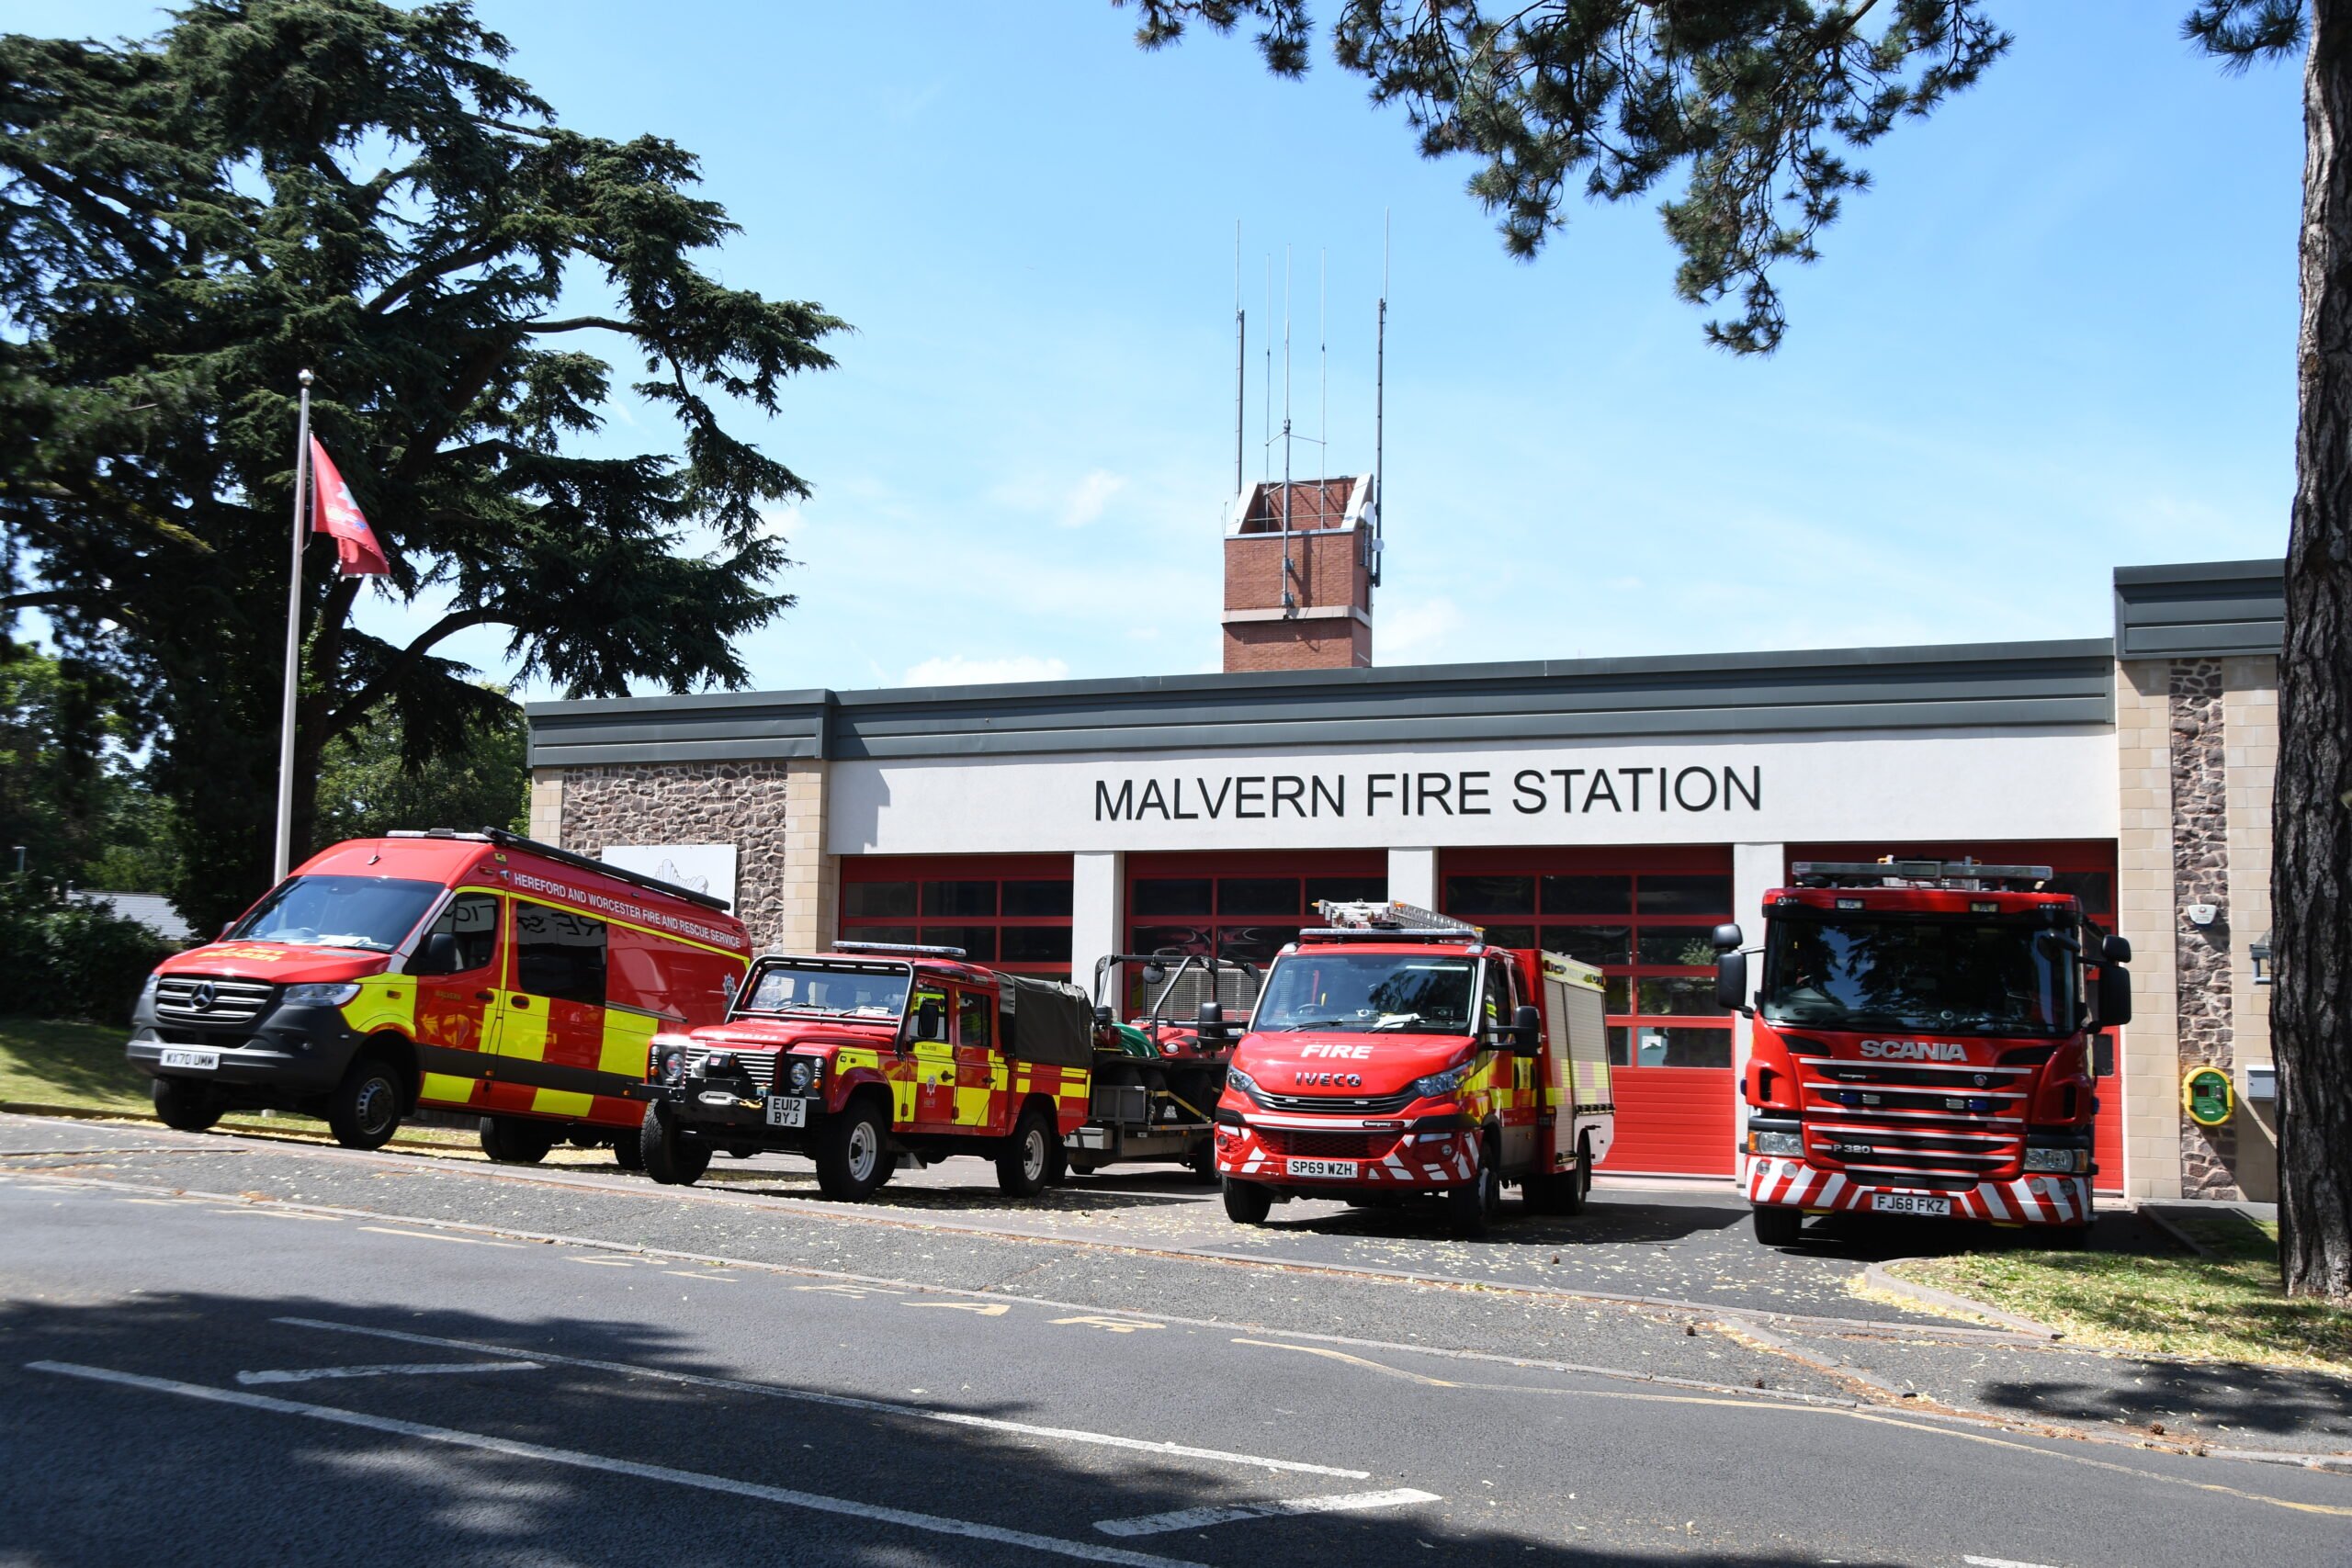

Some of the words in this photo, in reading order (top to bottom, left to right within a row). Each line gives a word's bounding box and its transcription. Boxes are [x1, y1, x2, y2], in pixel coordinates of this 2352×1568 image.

[1095, 774, 1345, 821] MALVERN
[1367, 772, 1491, 817] FIRE
[1512, 766, 1760, 815] STATION
[514, 873, 566, 897] HEREFORD
[568, 888, 587, 903] AND
[588, 893, 641, 919] WORCESTER
[642, 909, 661, 925] FIRE
[662, 916, 678, 930] AND
[679, 921, 709, 939] RESCUE
[711, 930, 741, 948] SERVICE
[1300, 1044, 1374, 1059] FIRE
[1859, 1040, 1969, 1062] SCANIA
[1295, 1071, 1363, 1087] IVECO
[773, 1098, 800, 1112] EU12
[1844, 1145, 1871, 1154] 320
[1292, 1160, 1324, 1174] SP69
[1328, 1162, 1352, 1176] WZH
[1877, 1196, 1914, 1211] FJ68
[1917, 1199, 1944, 1213] FKZ
